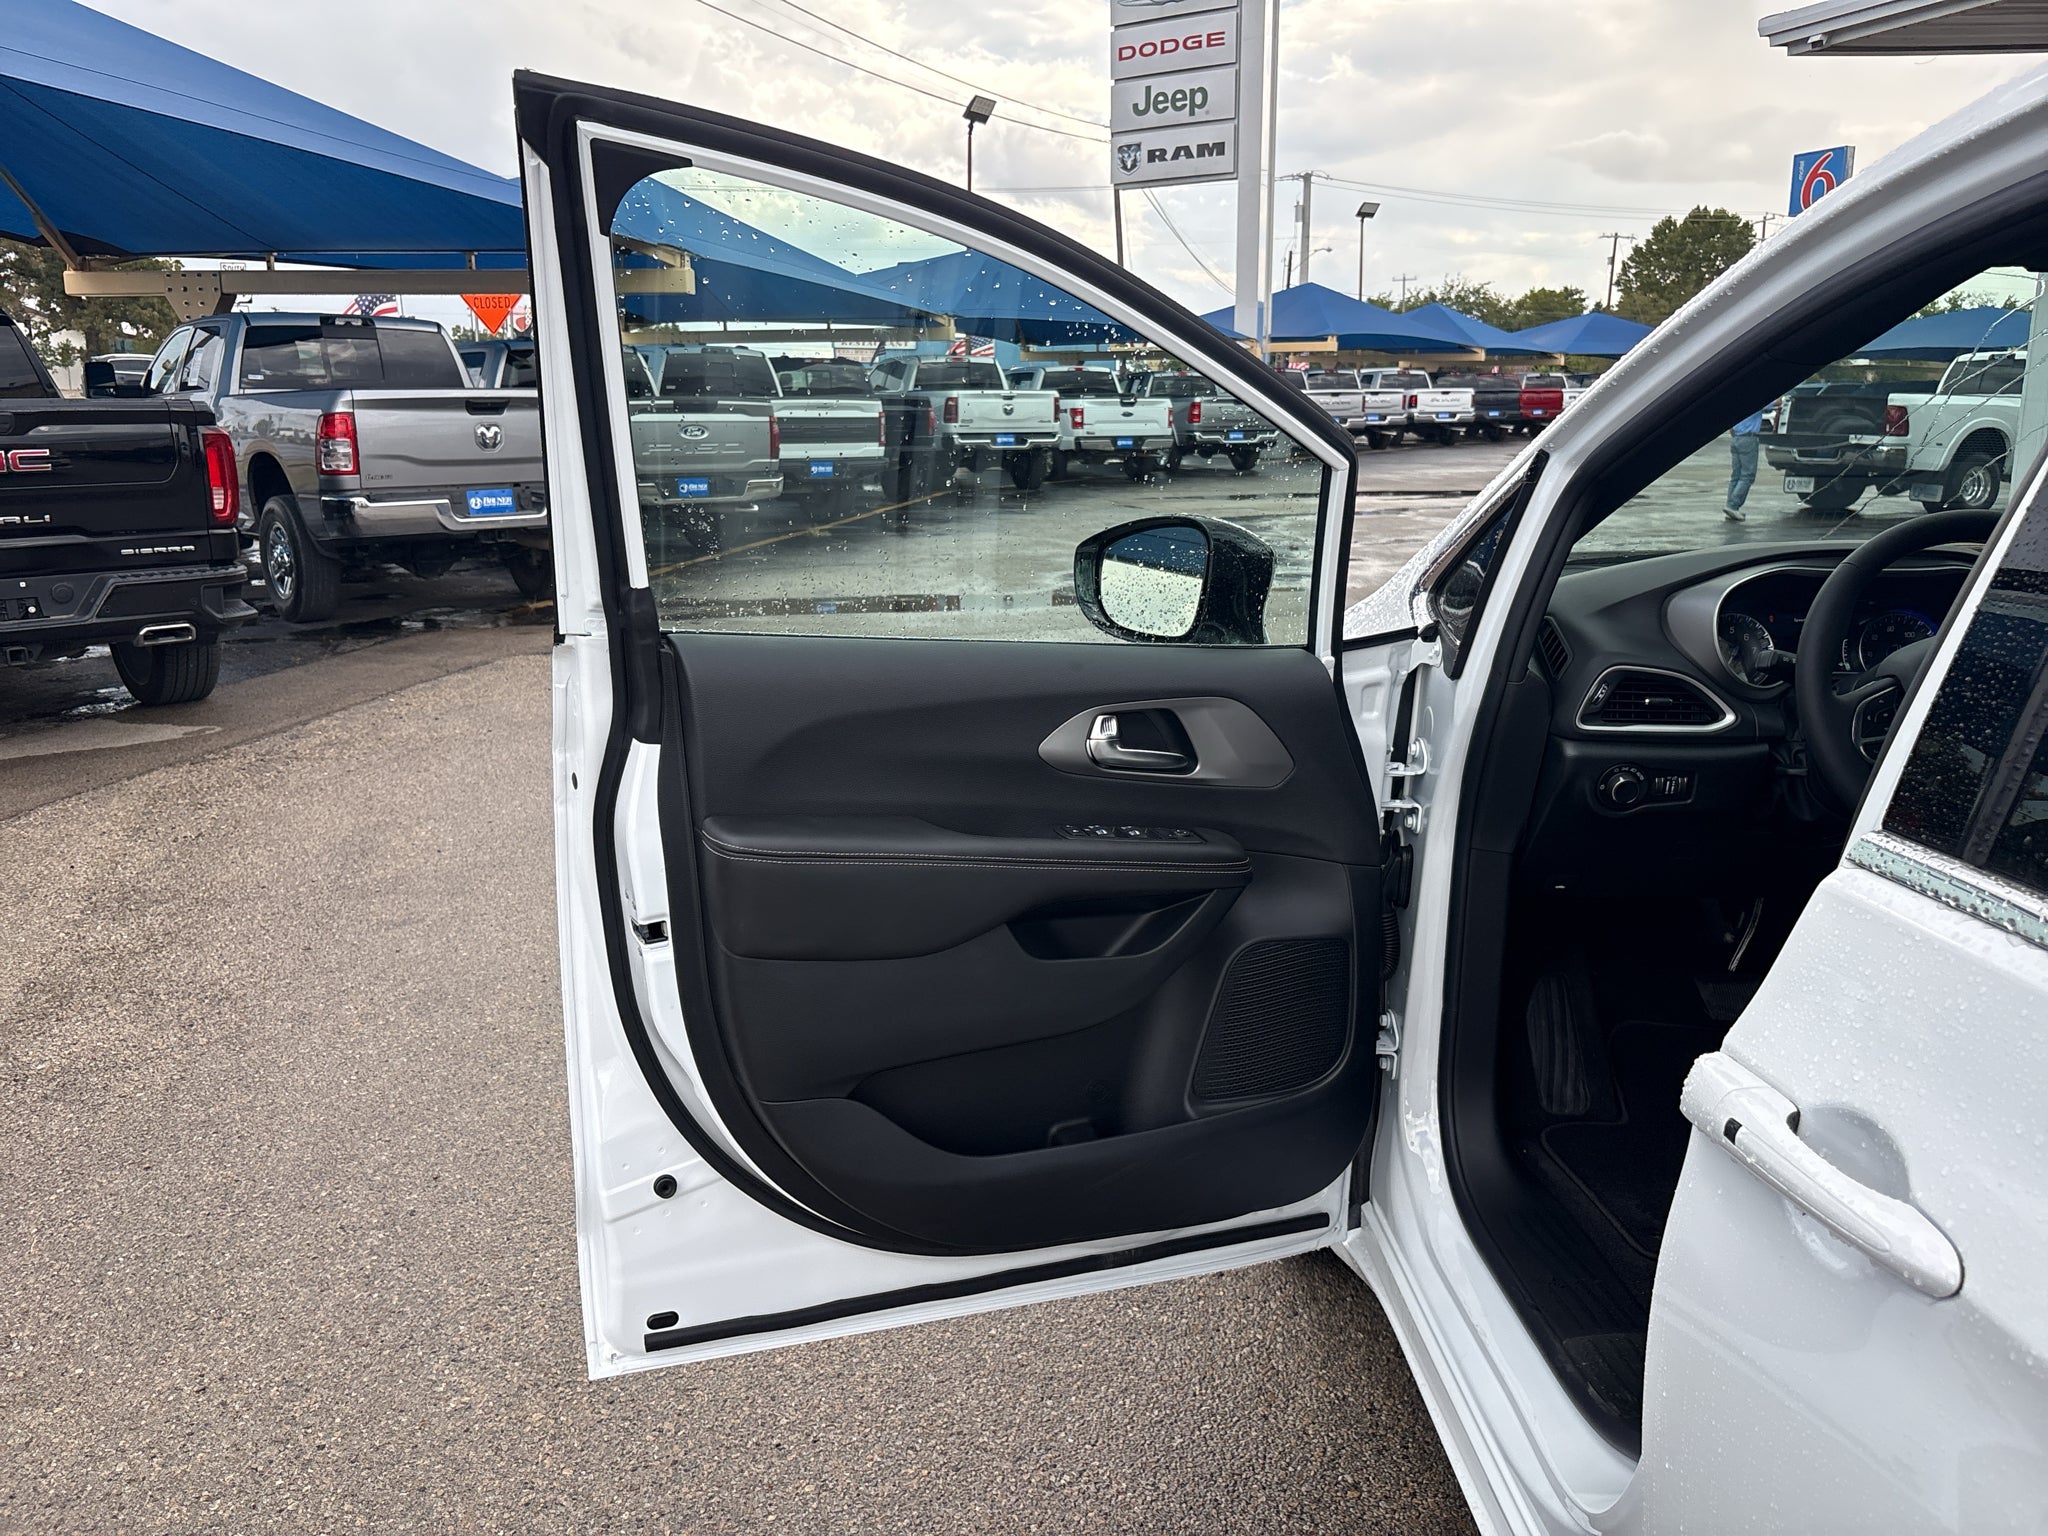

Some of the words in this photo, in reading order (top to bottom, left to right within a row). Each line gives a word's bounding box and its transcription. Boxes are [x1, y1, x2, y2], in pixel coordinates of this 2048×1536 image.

[1118, 31, 1226, 61] DODGE
[1132, 85, 1208, 117] Jeep
[1147, 141, 1226, 163] RAM
[1800, 152, 1836, 210] 6
[474, 297, 511, 309] CLOSED
[121, 545, 196, 555] SIERRA
